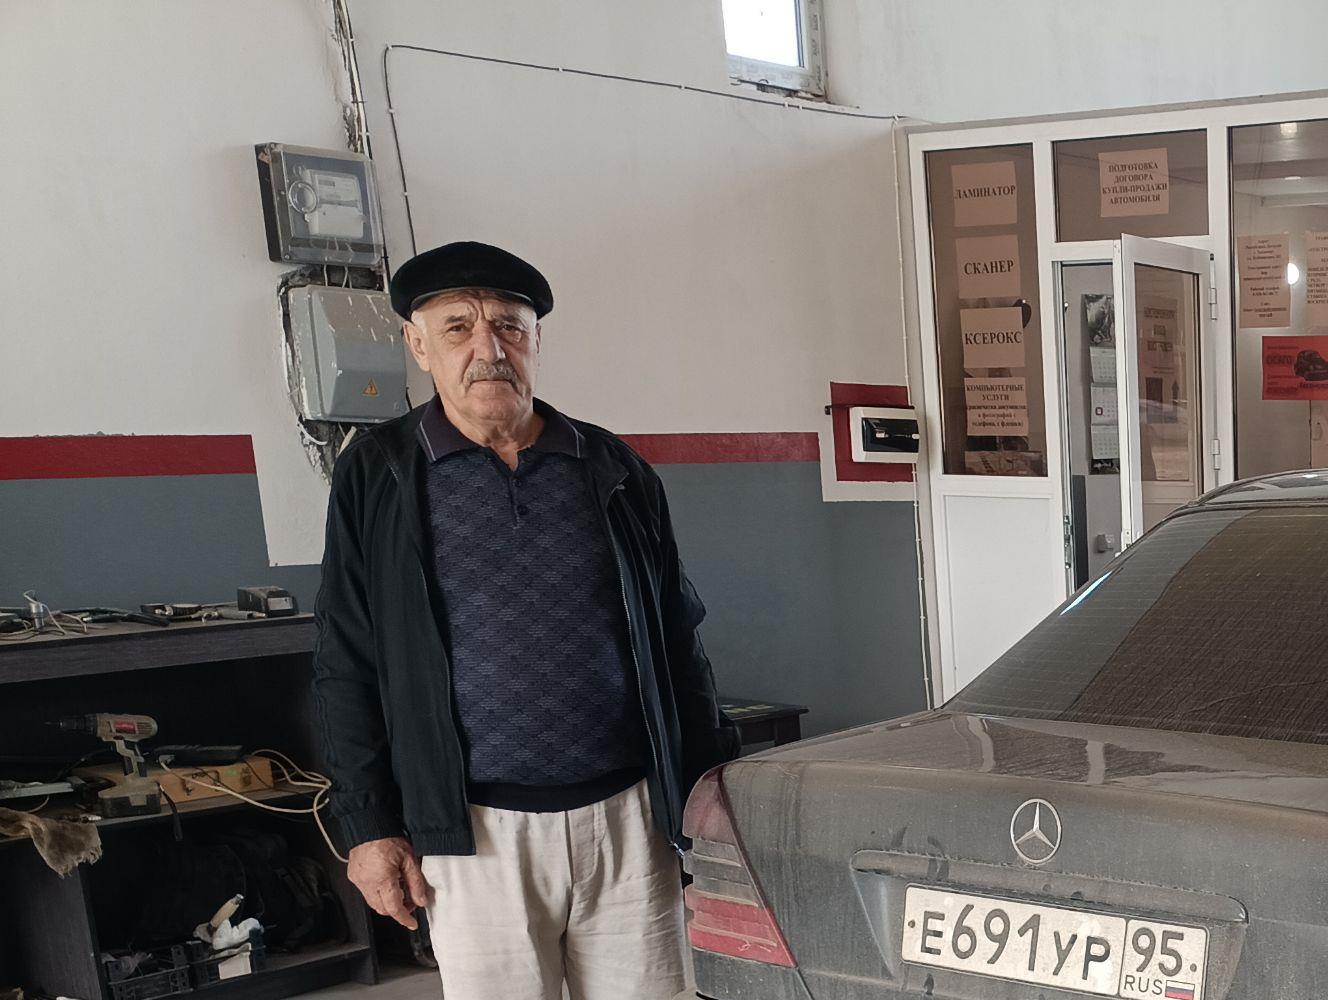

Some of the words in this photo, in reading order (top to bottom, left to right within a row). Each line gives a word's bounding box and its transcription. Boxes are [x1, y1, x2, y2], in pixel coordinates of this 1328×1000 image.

[1108, 161, 1159, 173] ПОДГОТОВКА
[1114, 172, 1154, 184] ДОГОВОРА
[954, 185, 1016, 199] ЛАМИНАТОР
[1102, 183, 1168, 194] КУПЛИ-ПРОДАЖИ
[1110, 194, 1161, 205] АВТОМОБИЛЯ
[963, 259, 1014, 275] СКАНЕР
[964, 331, 1023, 345] КСЕРОКС
[966, 384, 1025, 392] КОМПЬЮТЕРНЫЕ
[920, 903, 1111, 981] Е691УР
[1131, 926, 1185, 977] 95
[1123, 974, 1163, 996] RUS
